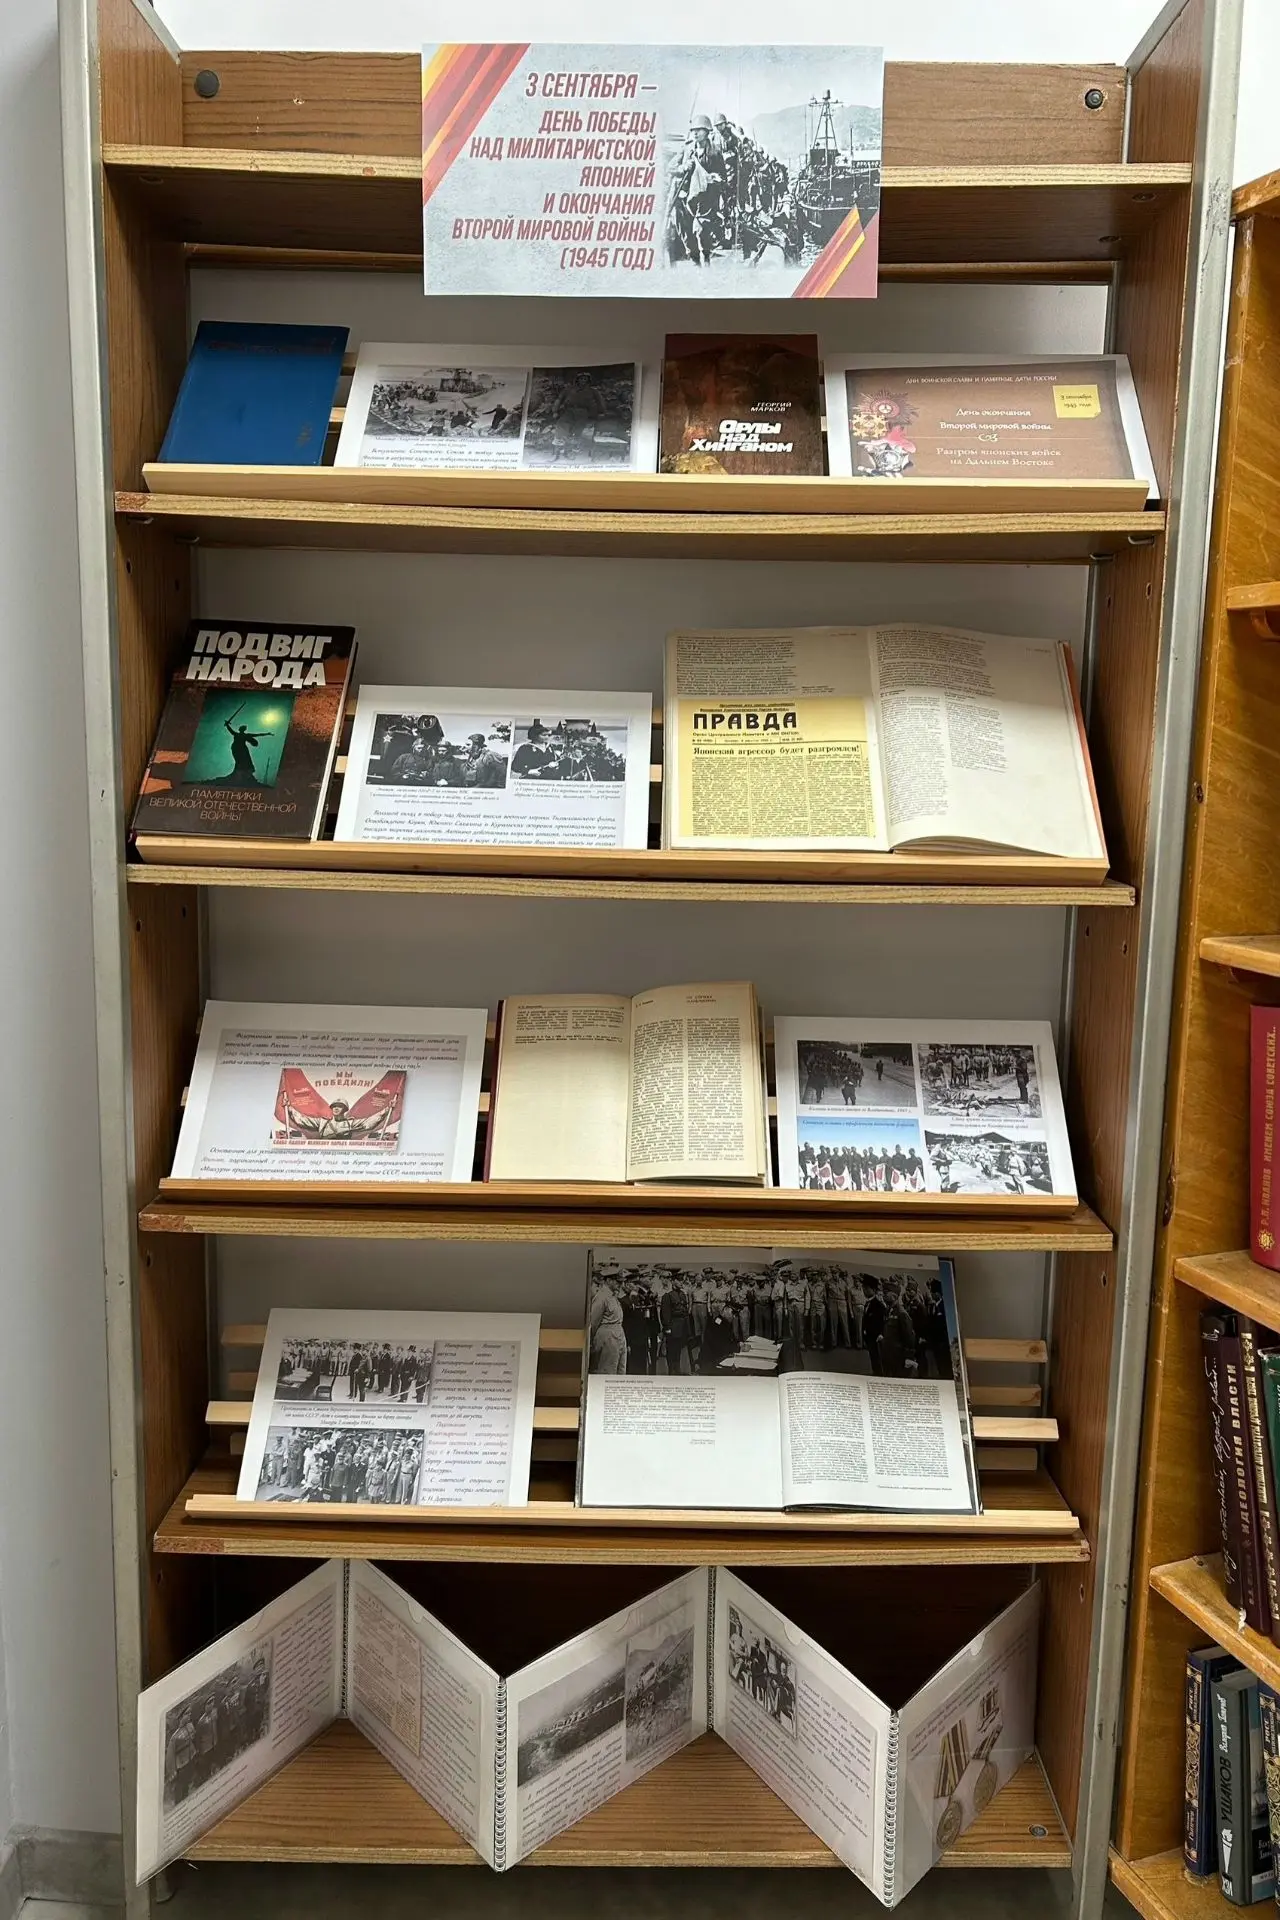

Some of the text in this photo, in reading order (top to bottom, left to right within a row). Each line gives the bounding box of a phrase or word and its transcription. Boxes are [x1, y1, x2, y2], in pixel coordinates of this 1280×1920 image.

[526, 73, 537, 97] 3
[541, 73, 638, 99] СЕНТЯБРЯ
[539, 110, 656, 134] ДЕНЬ ПОБЕДЫ
[470, 135, 656, 161] НАД МИЛИТАРИСТСКОЙ
[579, 163, 655, 187] ЯПОНИЕЙ
[543, 193, 654, 215] И ОКОНЧАНИЯ
[452, 214, 654, 241] ВТОРОЙ МИРОВОЙ ВОЙНЫ
[560, 246, 654, 270] (1945 ГОД)
[956, 408, 979, 417] День
[940, 422, 977, 431] Второй
[979, 423, 1019, 431] мировой
[936, 447, 978, 457] Разгром
[981, 448, 1029, 456] японских
[965, 458, 1009, 466] Дальнем
[1012, 458, 1054, 466] Востоке
[193, 630, 332, 661] ПОДВИГ
[185, 656, 327, 689] НАРОДА
[693, 712, 797, 731] ПРАВДА
[693, 745, 860, 756] Японский агрессор будет разгромлен!
[149, 797, 297, 813] ВЕЛИКОЙ ОТЕЧЕСТВЕННОЙ
[191, 789, 262, 801] ПАМЯТНИКИ
[200, 810, 242, 821] ВОЙНЫ
[315, 1079, 374, 1087] ПОБЕДИЛИ!
[1264, 1089, 1275, 1120] СОЮЗА
[1263, 1123, 1274, 1162] ИМЕНЕМ
[1261, 1168, 1272, 1206] ИВАНОВ
[1226, 1363, 1241, 1430] ВЛАСТИ
[1234, 1435, 1250, 1535] ИДЕОЛОГИЯ
[1220, 1757, 1234, 1824] УШАКОВ
